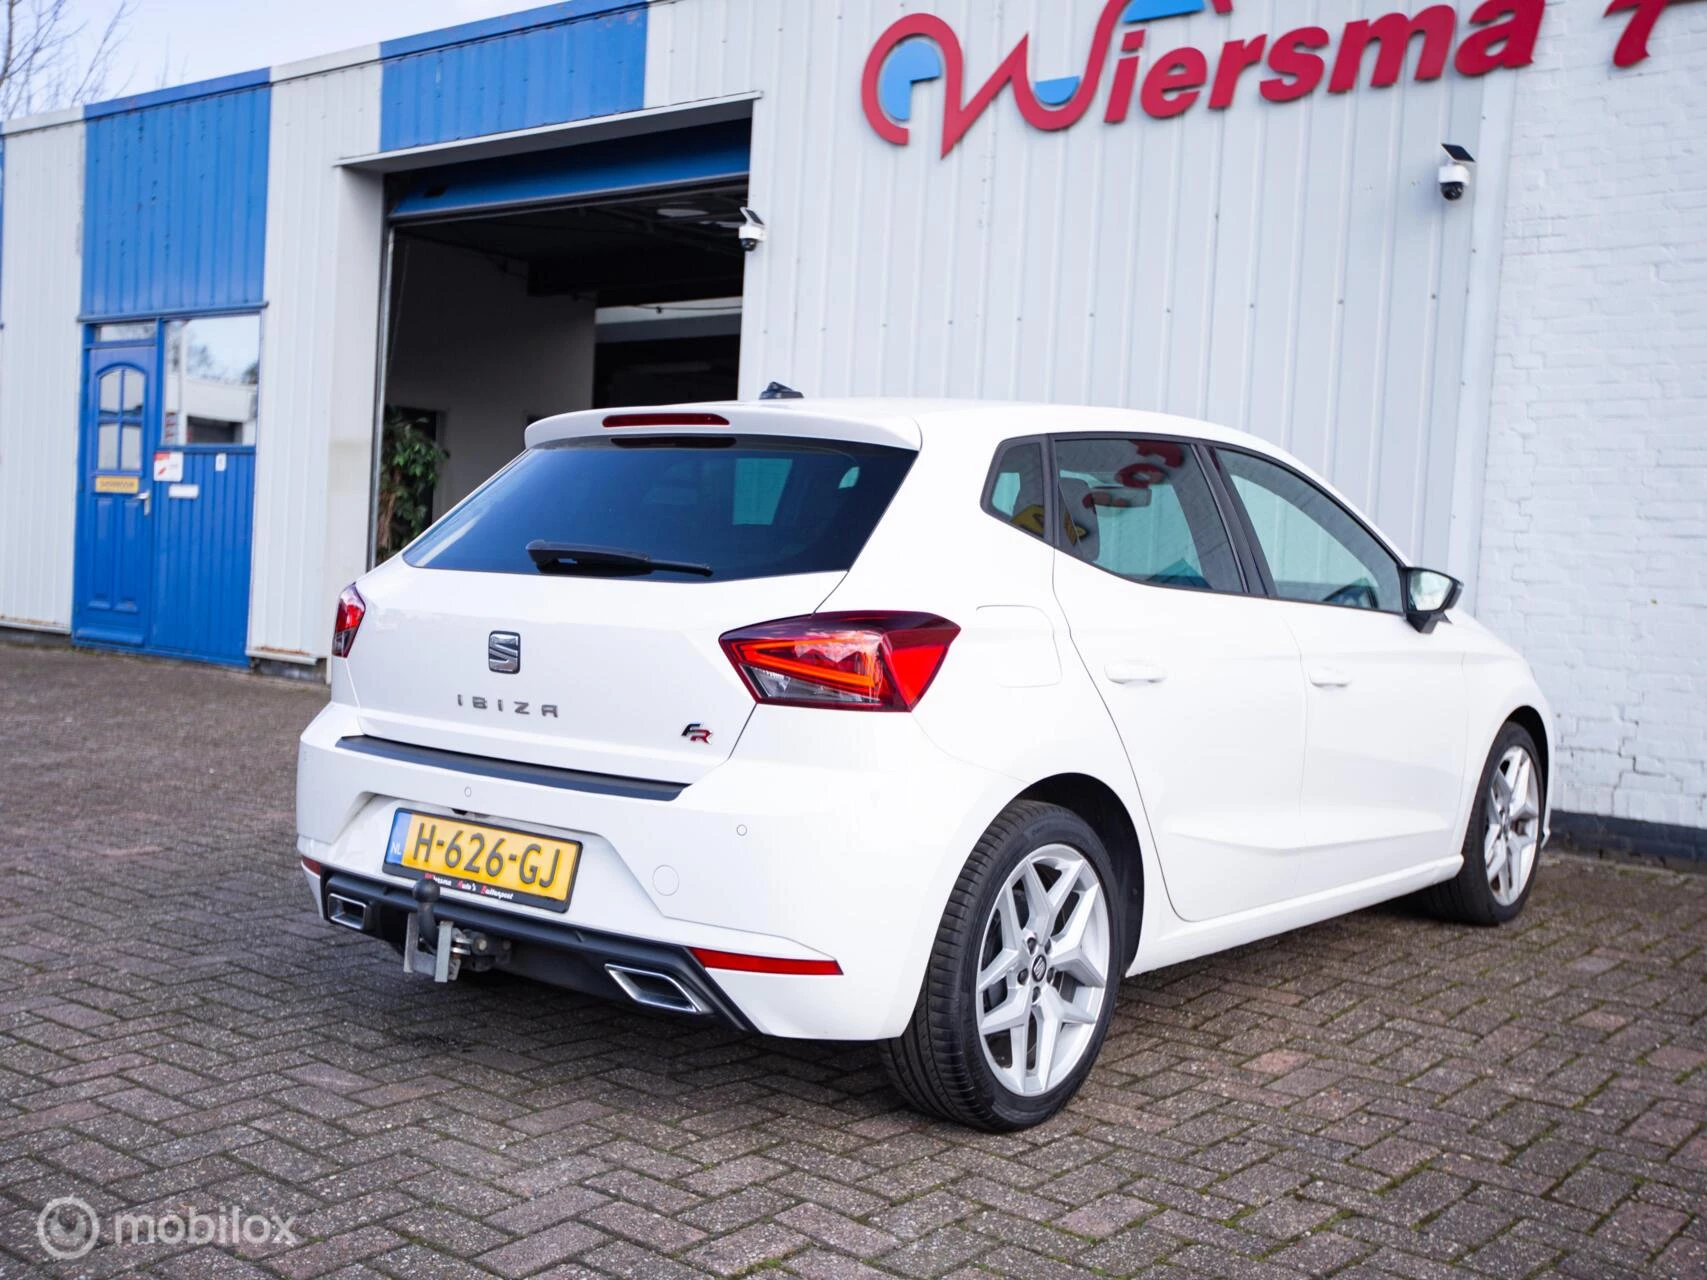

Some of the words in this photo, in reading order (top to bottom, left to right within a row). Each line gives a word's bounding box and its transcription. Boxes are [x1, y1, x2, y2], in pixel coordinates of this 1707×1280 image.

[861, 0, 1545, 159] Wiersma
[457, 694, 558, 718] IBIZA
[413, 822, 561, 888] H-626-GJ
